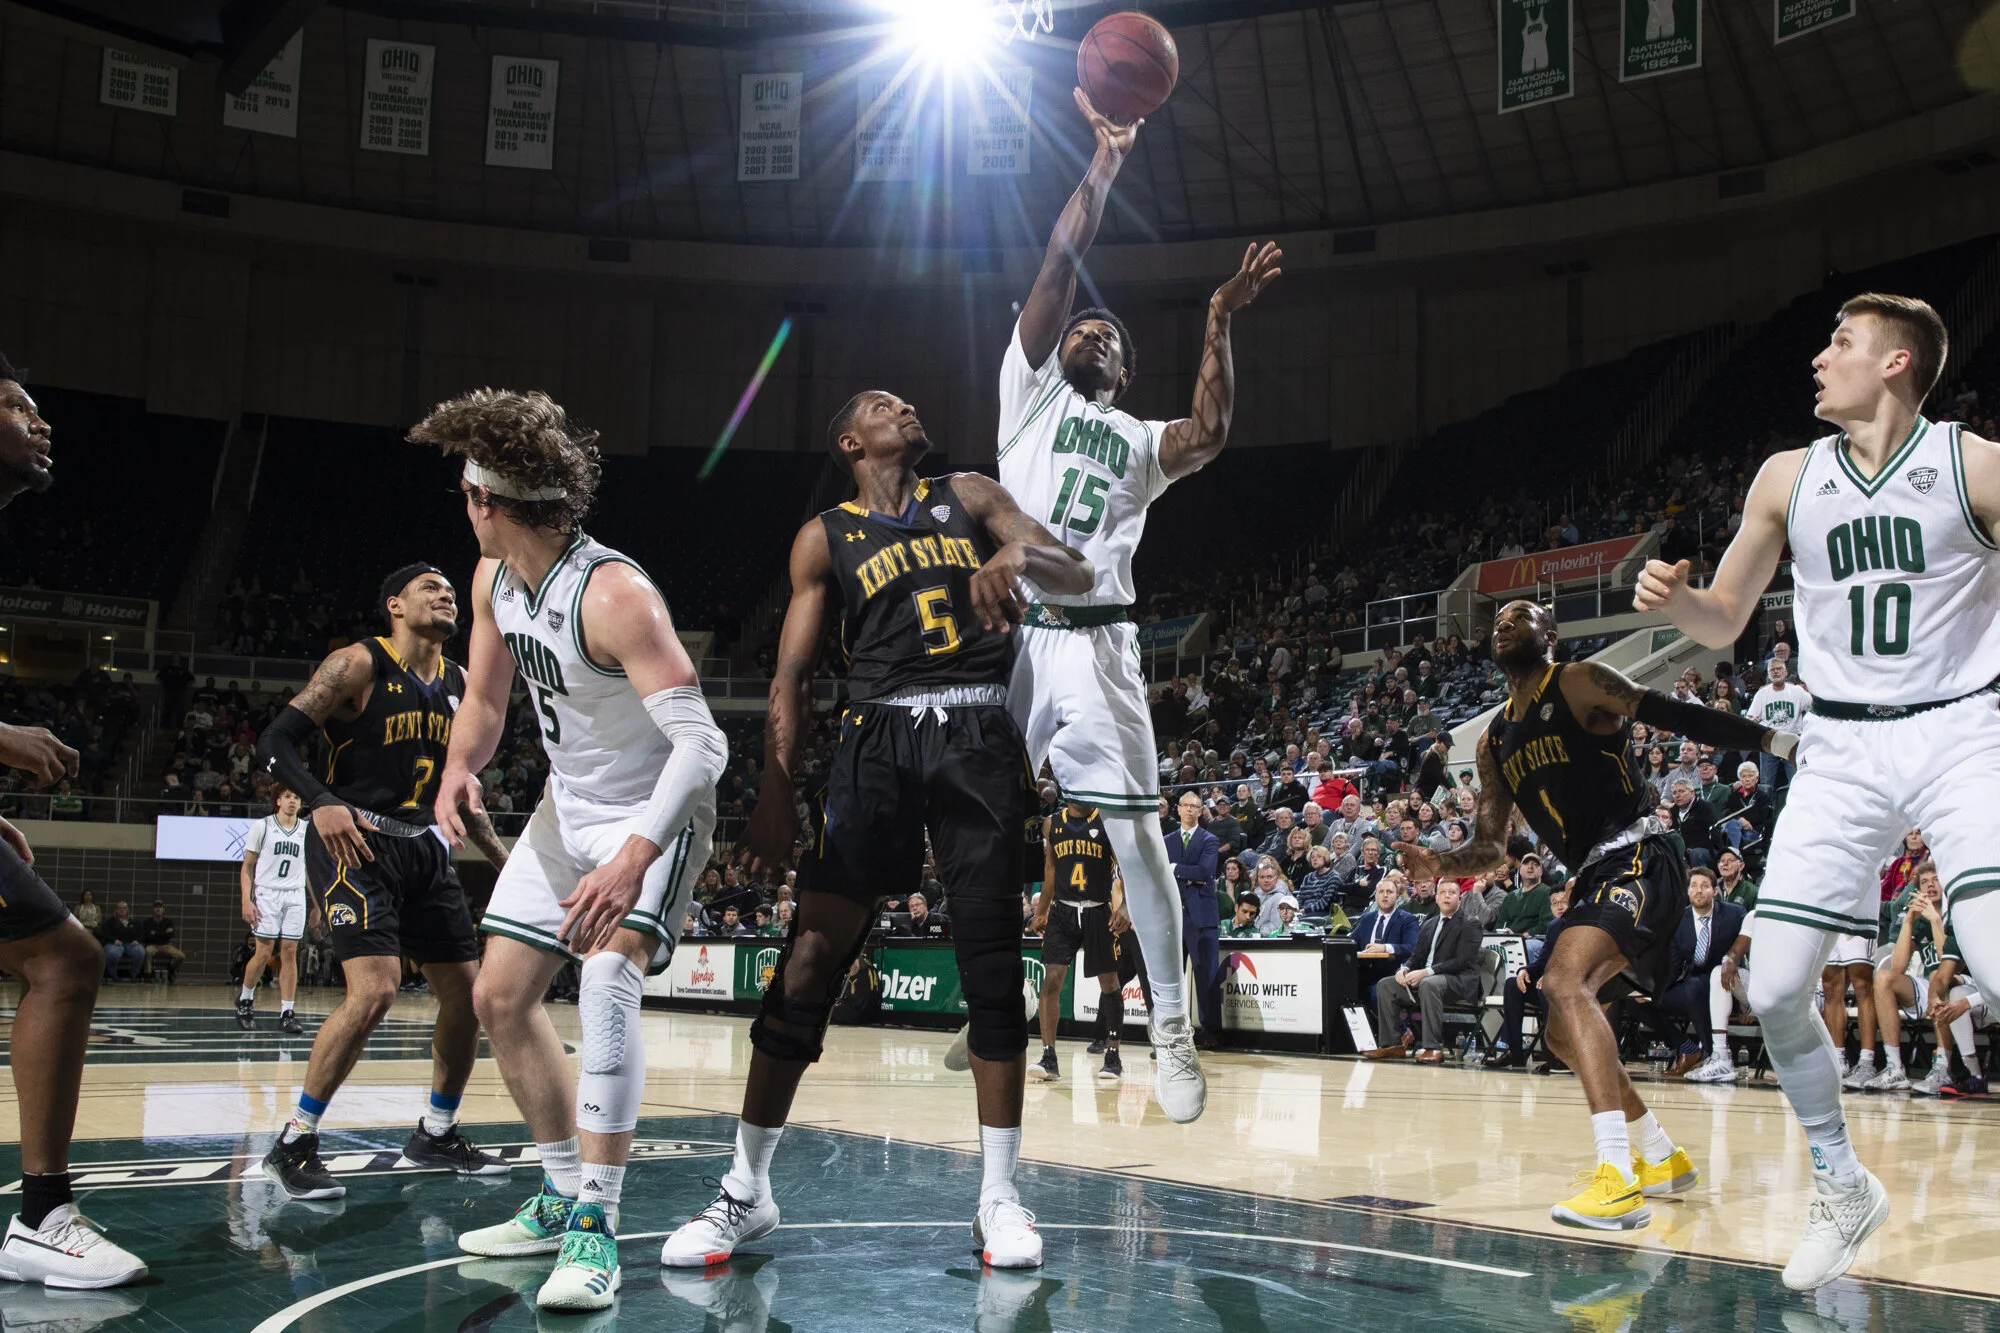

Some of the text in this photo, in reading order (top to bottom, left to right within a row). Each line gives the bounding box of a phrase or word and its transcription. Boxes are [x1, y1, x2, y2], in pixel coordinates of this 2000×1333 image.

[1783, 0, 1840, 23] CHAMPIO
[1795, 7, 1833, 29] 1978
[1628, 44, 1693, 63] CHAMPION
[1630, 37, 1690, 54] NATIONAL
[381, 48, 420, 73] OHIO
[1641, 55, 1680, 71] 1964
[260, 69, 276, 80] AC
[506, 64, 543, 88] OHIO
[1508, 68, 1563, 87] NATIONAL
[252, 78, 292, 93] MPIONS
[387, 84, 409, 96] MAC
[754, 80, 789, 101] OHIO
[1506, 74, 1566, 95] CHAMPION
[109, 89, 136, 102] 2007
[241, 91, 259, 103] 012
[367, 91, 428, 107] TOURNAMENT
[233, 100, 258, 113] 2014
[370, 102, 425, 117] CHAMPIONS
[492, 107, 552, 122] TOURNAMENT
[512, 100, 533, 111] MAC
[495, 118, 549, 131] CHAMPIONS
[759, 122, 782, 131] NCAA
[523, 133, 547, 144] 2013
[742, 130, 797, 141] TOURNAMENT
[974, 138, 1024, 151] SWEET 16
[982, 155, 1016, 169] 2005
[1052, 416, 1130, 480] OHIO
[1050, 467, 1111, 535] 15
[1816, 488, 1841, 497] adidas
[1826, 515, 1926, 582] OHIO
[855, 533, 983, 600] KENT STATE
[85, 602, 147, 620] Holzer
[1762, 595, 1795, 609] ERVE
[911, 584, 963, 658] 5
[1847, 582, 1913, 657] 10
[503, 632, 570, 697] OHIO
[536, 685, 561, 745] 5
[1765, 701, 1795, 721] OHIO
[383, 710, 451, 747] KENT STA
[1525, 735, 1570, 772] STATE
[1538, 788, 1568, 841] 1
[273, 840, 300, 858] OHIO
[1053, 839, 1103, 859] KENT STATE
[277, 859, 291, 878] 0
[1070, 861, 1088, 893] 4
[691, 966, 715, 987] Wendy's
[873, 963, 937, 1001] olzer
[1226, 982, 1298, 997] DAVID WHITE
[881, 1002, 894, 1011] stem
[1083, 1005, 1099, 1015] Three
[1225, 999, 1277, 1010] SERVICES, INC.
